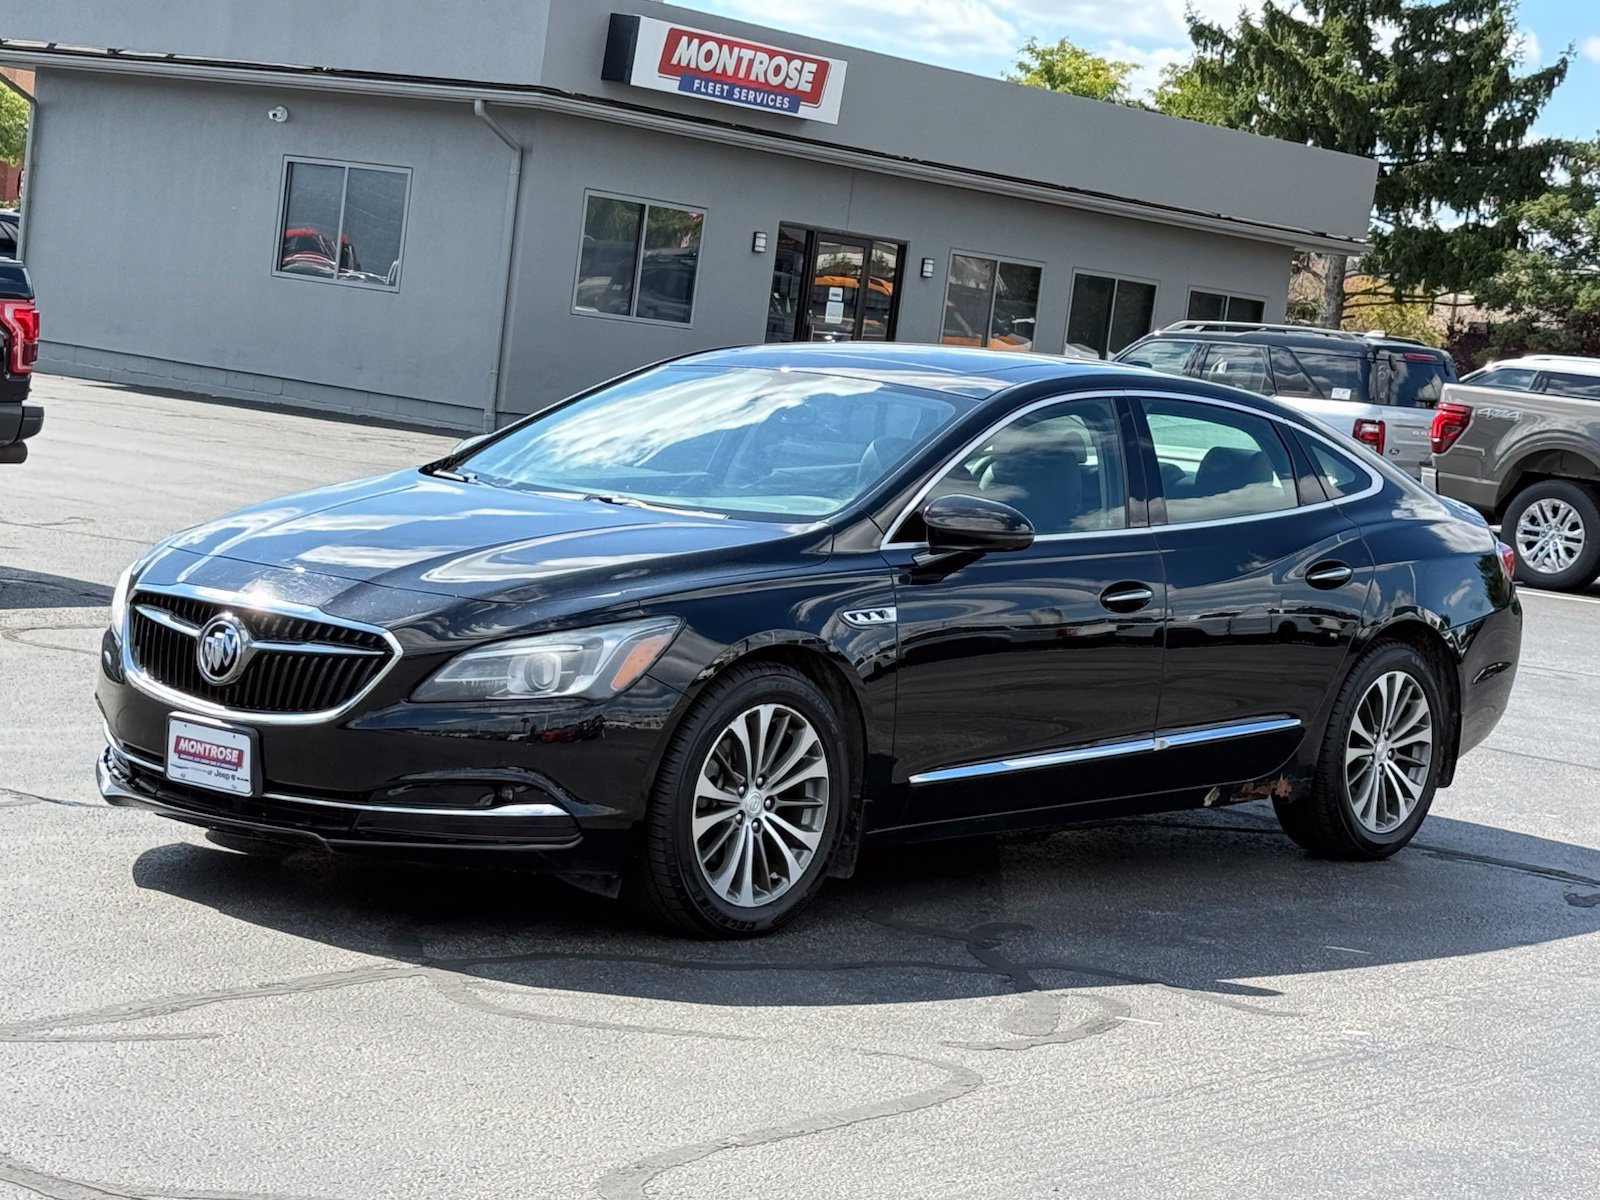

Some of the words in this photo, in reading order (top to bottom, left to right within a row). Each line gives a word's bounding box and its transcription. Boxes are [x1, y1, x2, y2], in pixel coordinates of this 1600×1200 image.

[671, 36, 818, 92] MONTROSE
[693, 79, 729, 97] FLEET
[733, 88, 790, 109] SERVICES
[178, 738, 240, 763] MONTROSE
[214, 769, 231, 781] Jeep
